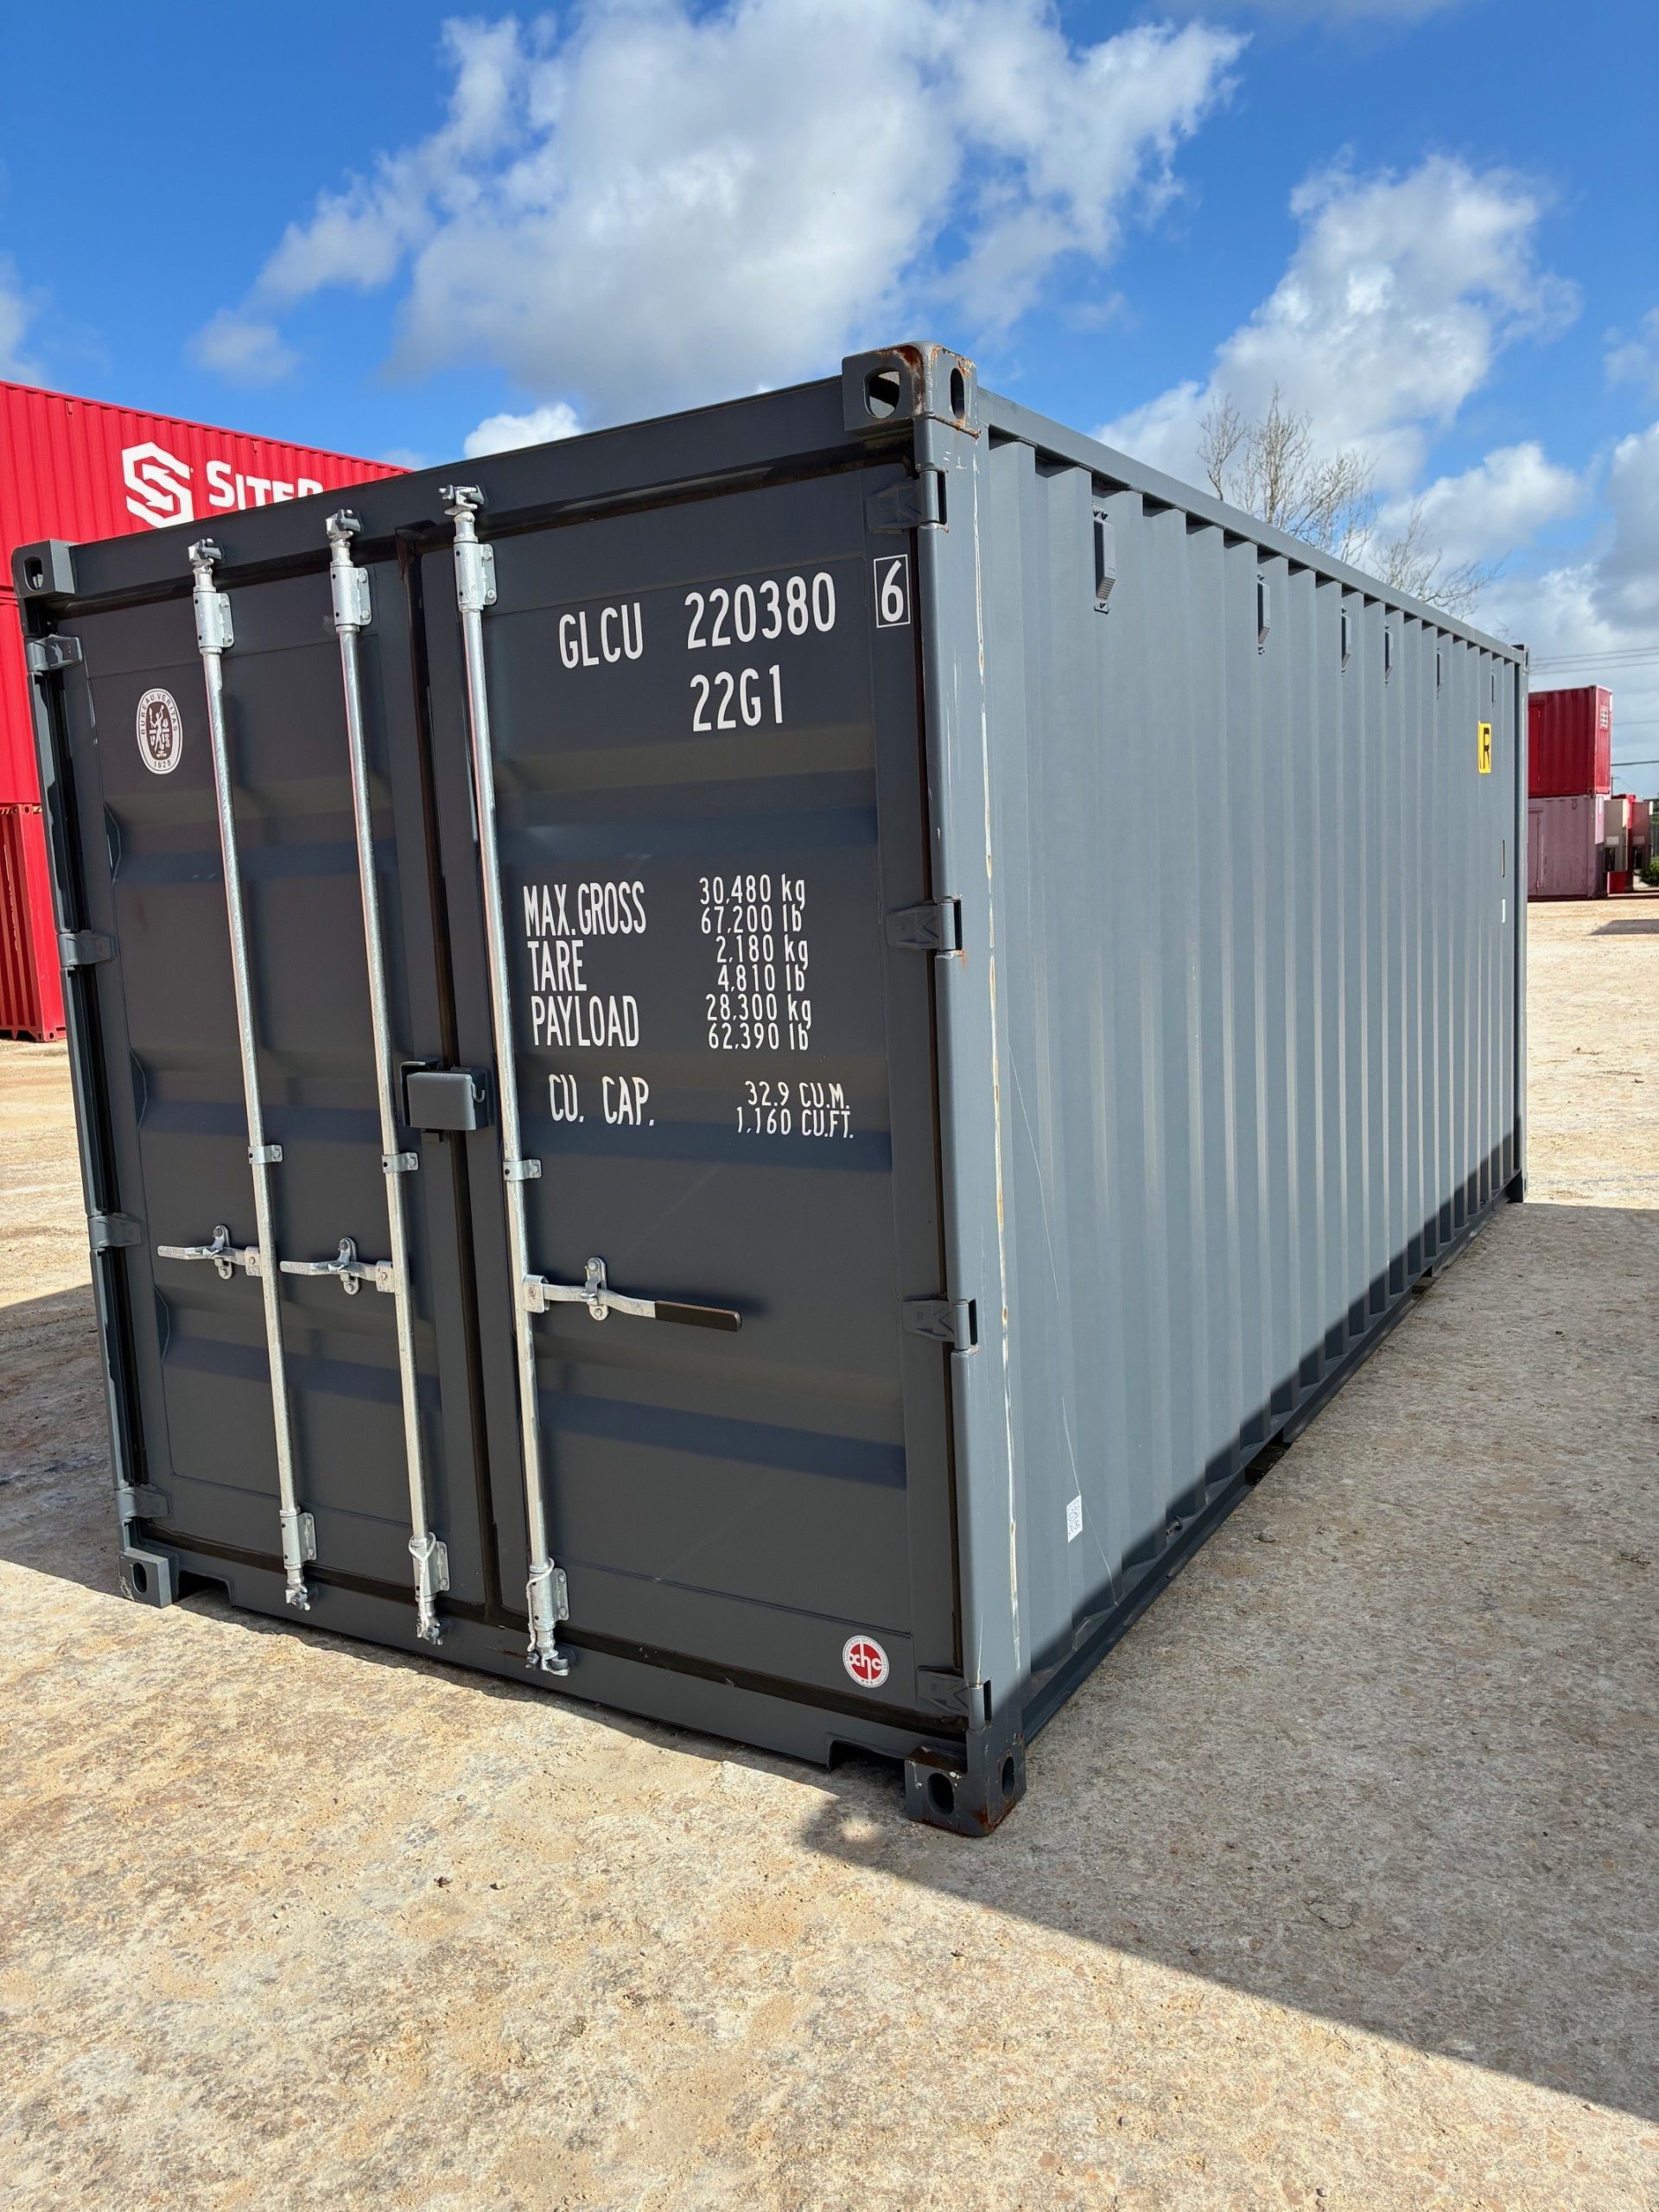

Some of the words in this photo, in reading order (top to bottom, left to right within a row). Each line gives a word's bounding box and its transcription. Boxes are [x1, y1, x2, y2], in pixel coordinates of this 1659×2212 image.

[559, 601, 644, 669] GLCU
[684, 571, 836, 650] 220380
[880, 559, 904, 622] 6
[141, 695, 155, 735] BUREAU
[157, 693, 178, 732] VERITAS
[690, 664, 783, 733] 22G1
[698, 874, 772, 905] 30,480
[781, 873, 805, 911] kg
[701, 904, 772, 935] 67,200
[782, 903, 802, 932] lb
[526, 939, 588, 992] TARE
[715, 933, 774, 963] 2,180
[784, 933, 809, 971] kg
[717, 963, 776, 992] 4,810
[785, 963, 805, 992] lb
[531, 995, 639, 1047] PAYLOAD
[705, 993, 778, 1021] 28,300
[787, 993, 812, 1031] kg
[708, 1021, 779, 1050] 62,390
[789, 1022, 809, 1051] lb
[548, 1073, 585, 1123] CU.
[601, 1076, 655, 1127] CAP.
[744, 1080, 790, 1107] 32.9
[736, 1106, 791, 1135] 1,160
